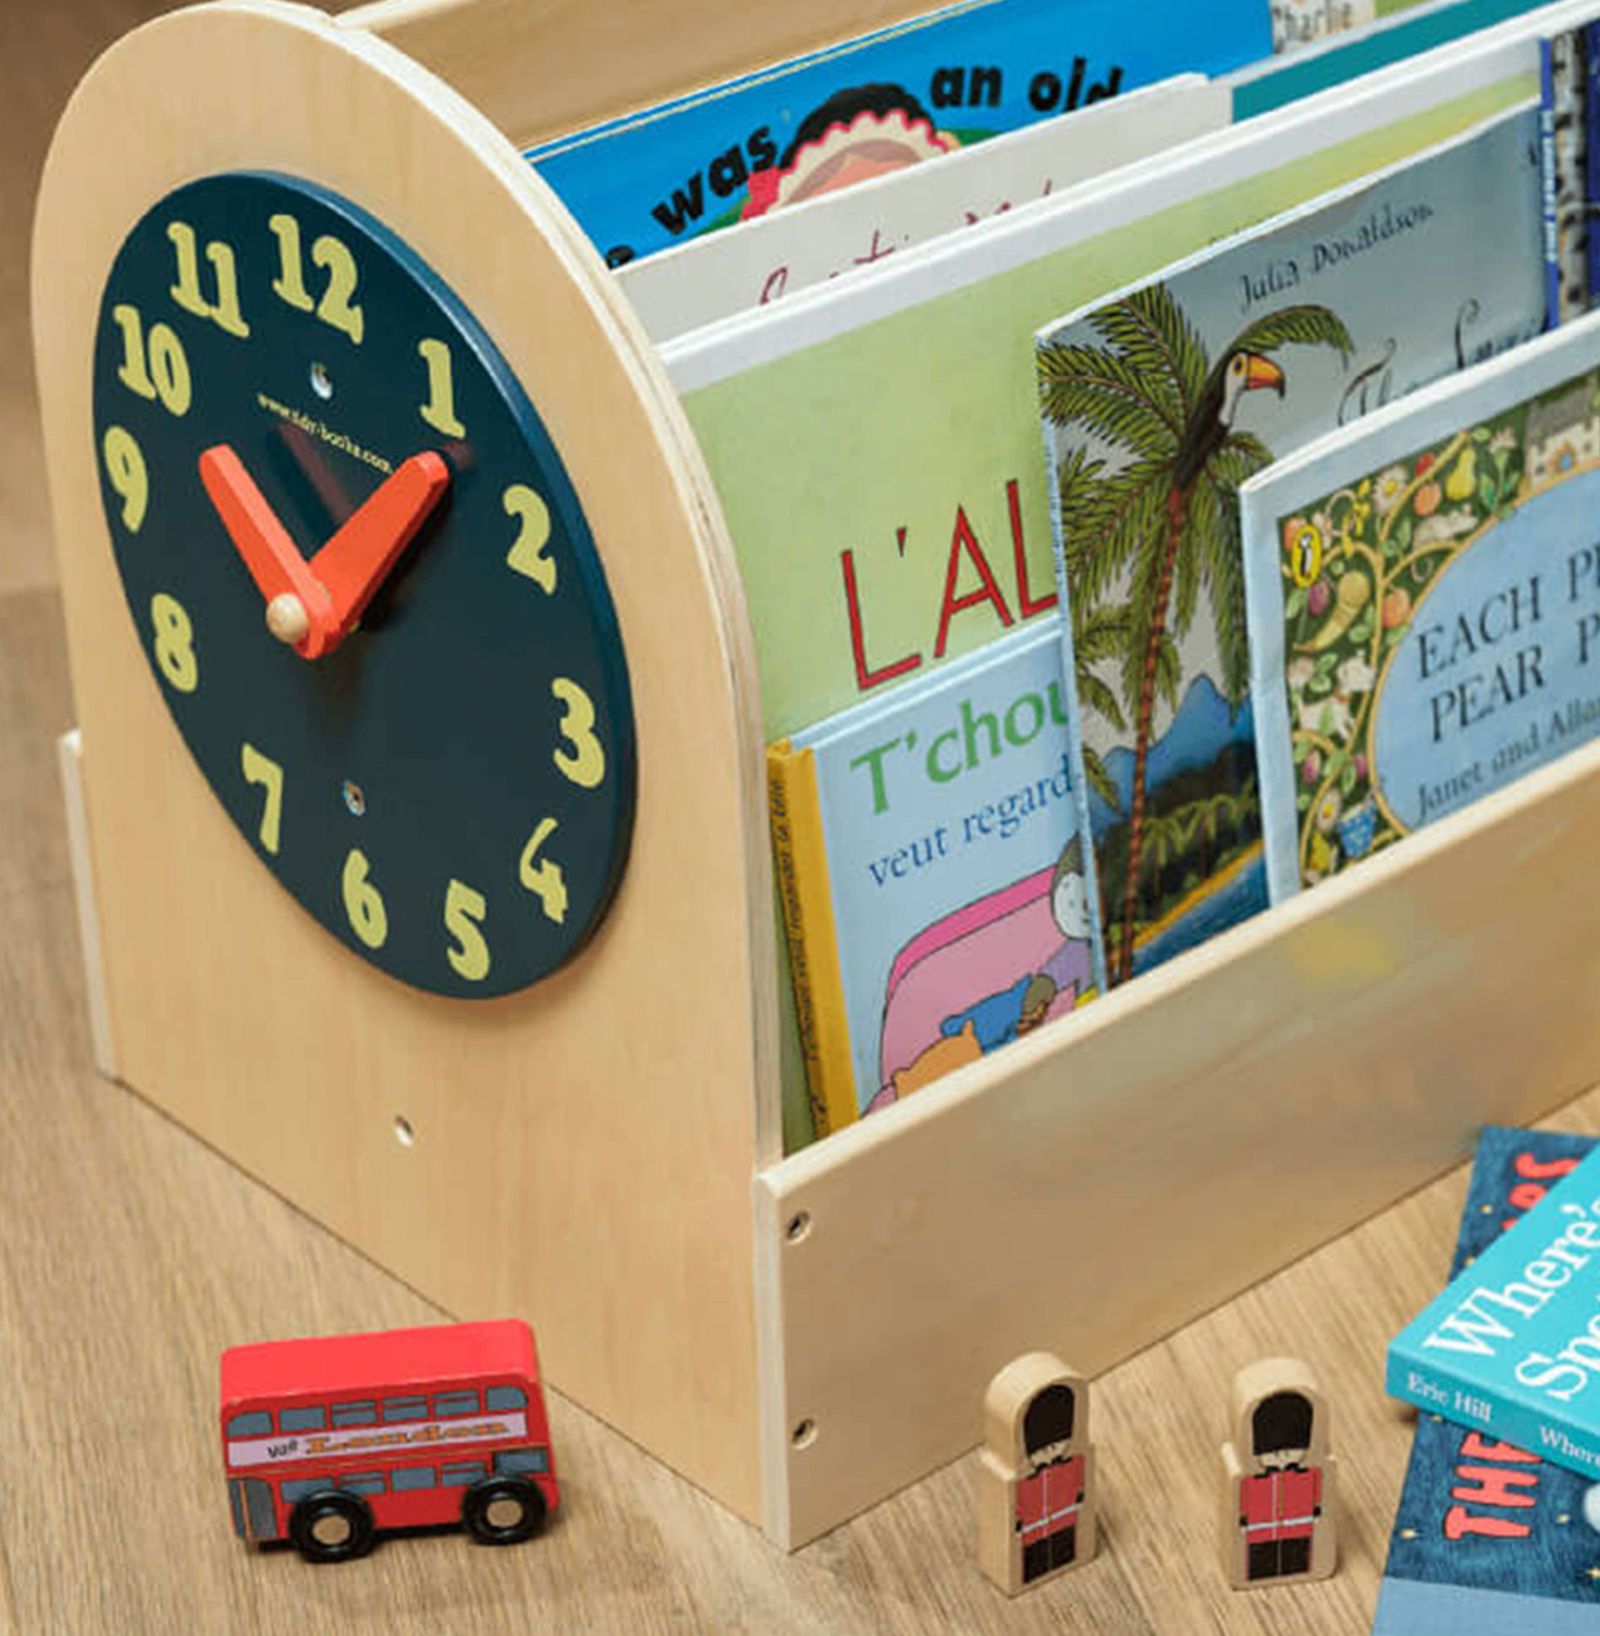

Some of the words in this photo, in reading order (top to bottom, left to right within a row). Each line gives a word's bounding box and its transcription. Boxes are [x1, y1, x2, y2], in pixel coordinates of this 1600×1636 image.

[651, 126, 777, 235] was
[931, 66, 1003, 109] an
[167, 222, 250, 338] 11
[269, 214, 364, 344] 12
[1240, 259, 1300, 314] Julia
[1312, 202, 1434, 274] Donaldson
[113, 305, 192, 417] 10
[418, 338, 466, 439] 1
[104, 425, 148, 533] 9
[503, 484, 557, 595] 2
[841, 478, 1059, 690] L'AL
[151, 593, 198, 692] 8
[1418, 576, 1540, 679] EACH
[1568, 544, 1600, 602] P
[551, 677, 605, 789] 3
[1431, 645, 1543, 742] PEAR
[241, 742, 284, 854] 7
[1413, 761, 1483, 826] Janet
[1492, 722, 1540, 773] and
[1547, 697, 1600, 744] Alla
[342, 849, 387, 949] 6
[519, 817, 568, 924] 4
[868, 828, 948, 887] veut
[444, 878, 490, 981] 5
[1407, 1371, 1449, 1405] Eric
[1454, 1391, 1493, 1423] Hill
